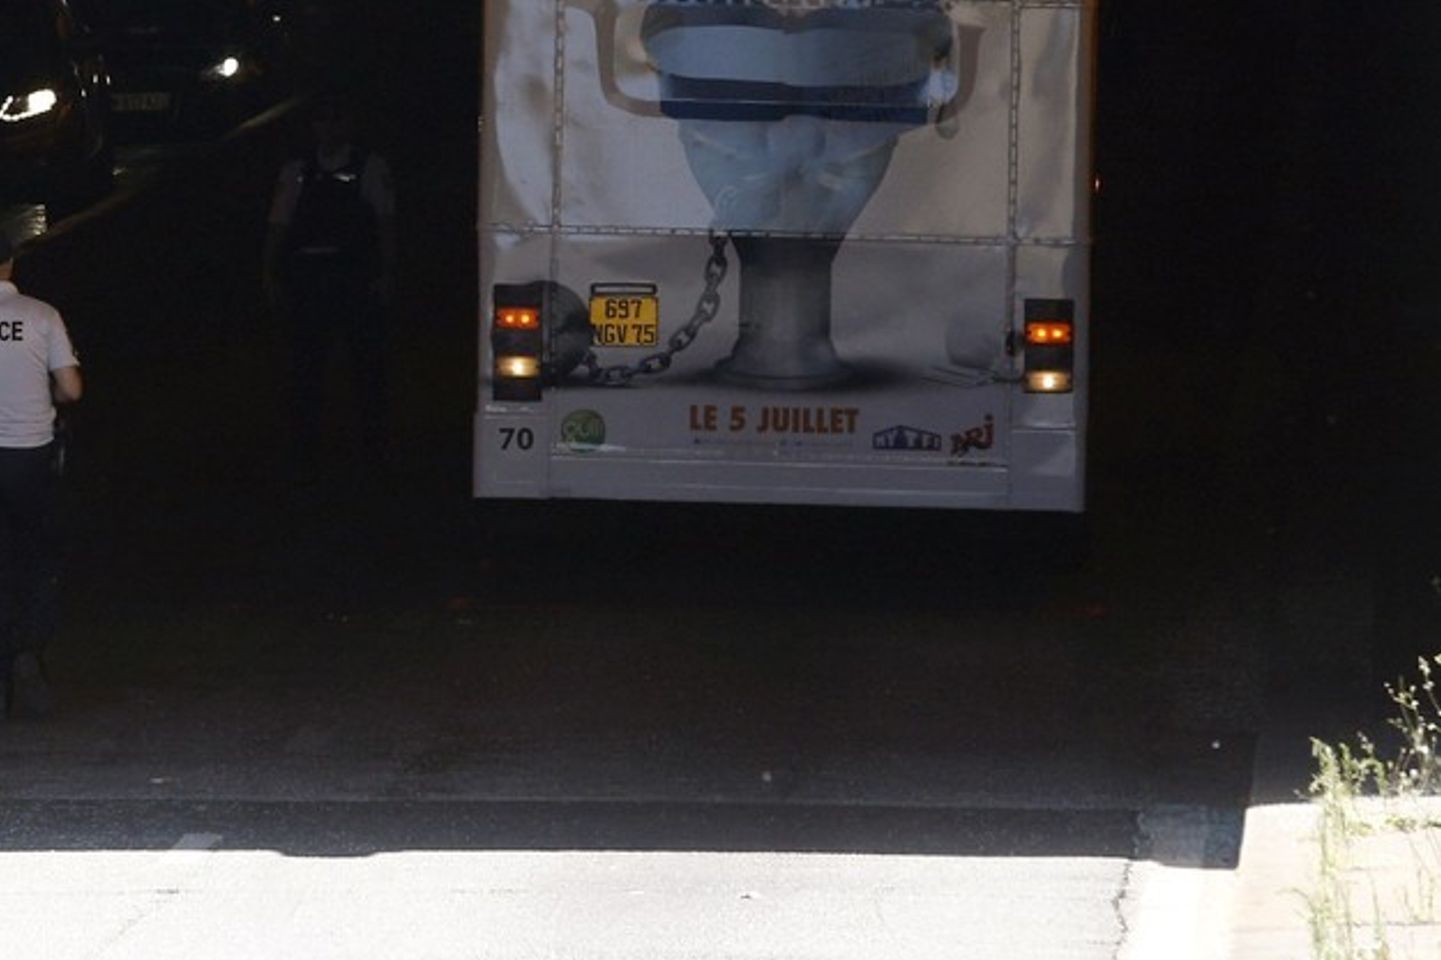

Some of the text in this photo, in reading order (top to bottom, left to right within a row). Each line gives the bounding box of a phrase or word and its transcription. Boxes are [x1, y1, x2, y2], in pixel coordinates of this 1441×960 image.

[605, 298, 643, 318] 697
[631, 324, 656, 344] 75
[689, 404, 859, 434] LE 5 JUILLET
[498, 427, 535, 451] 70
